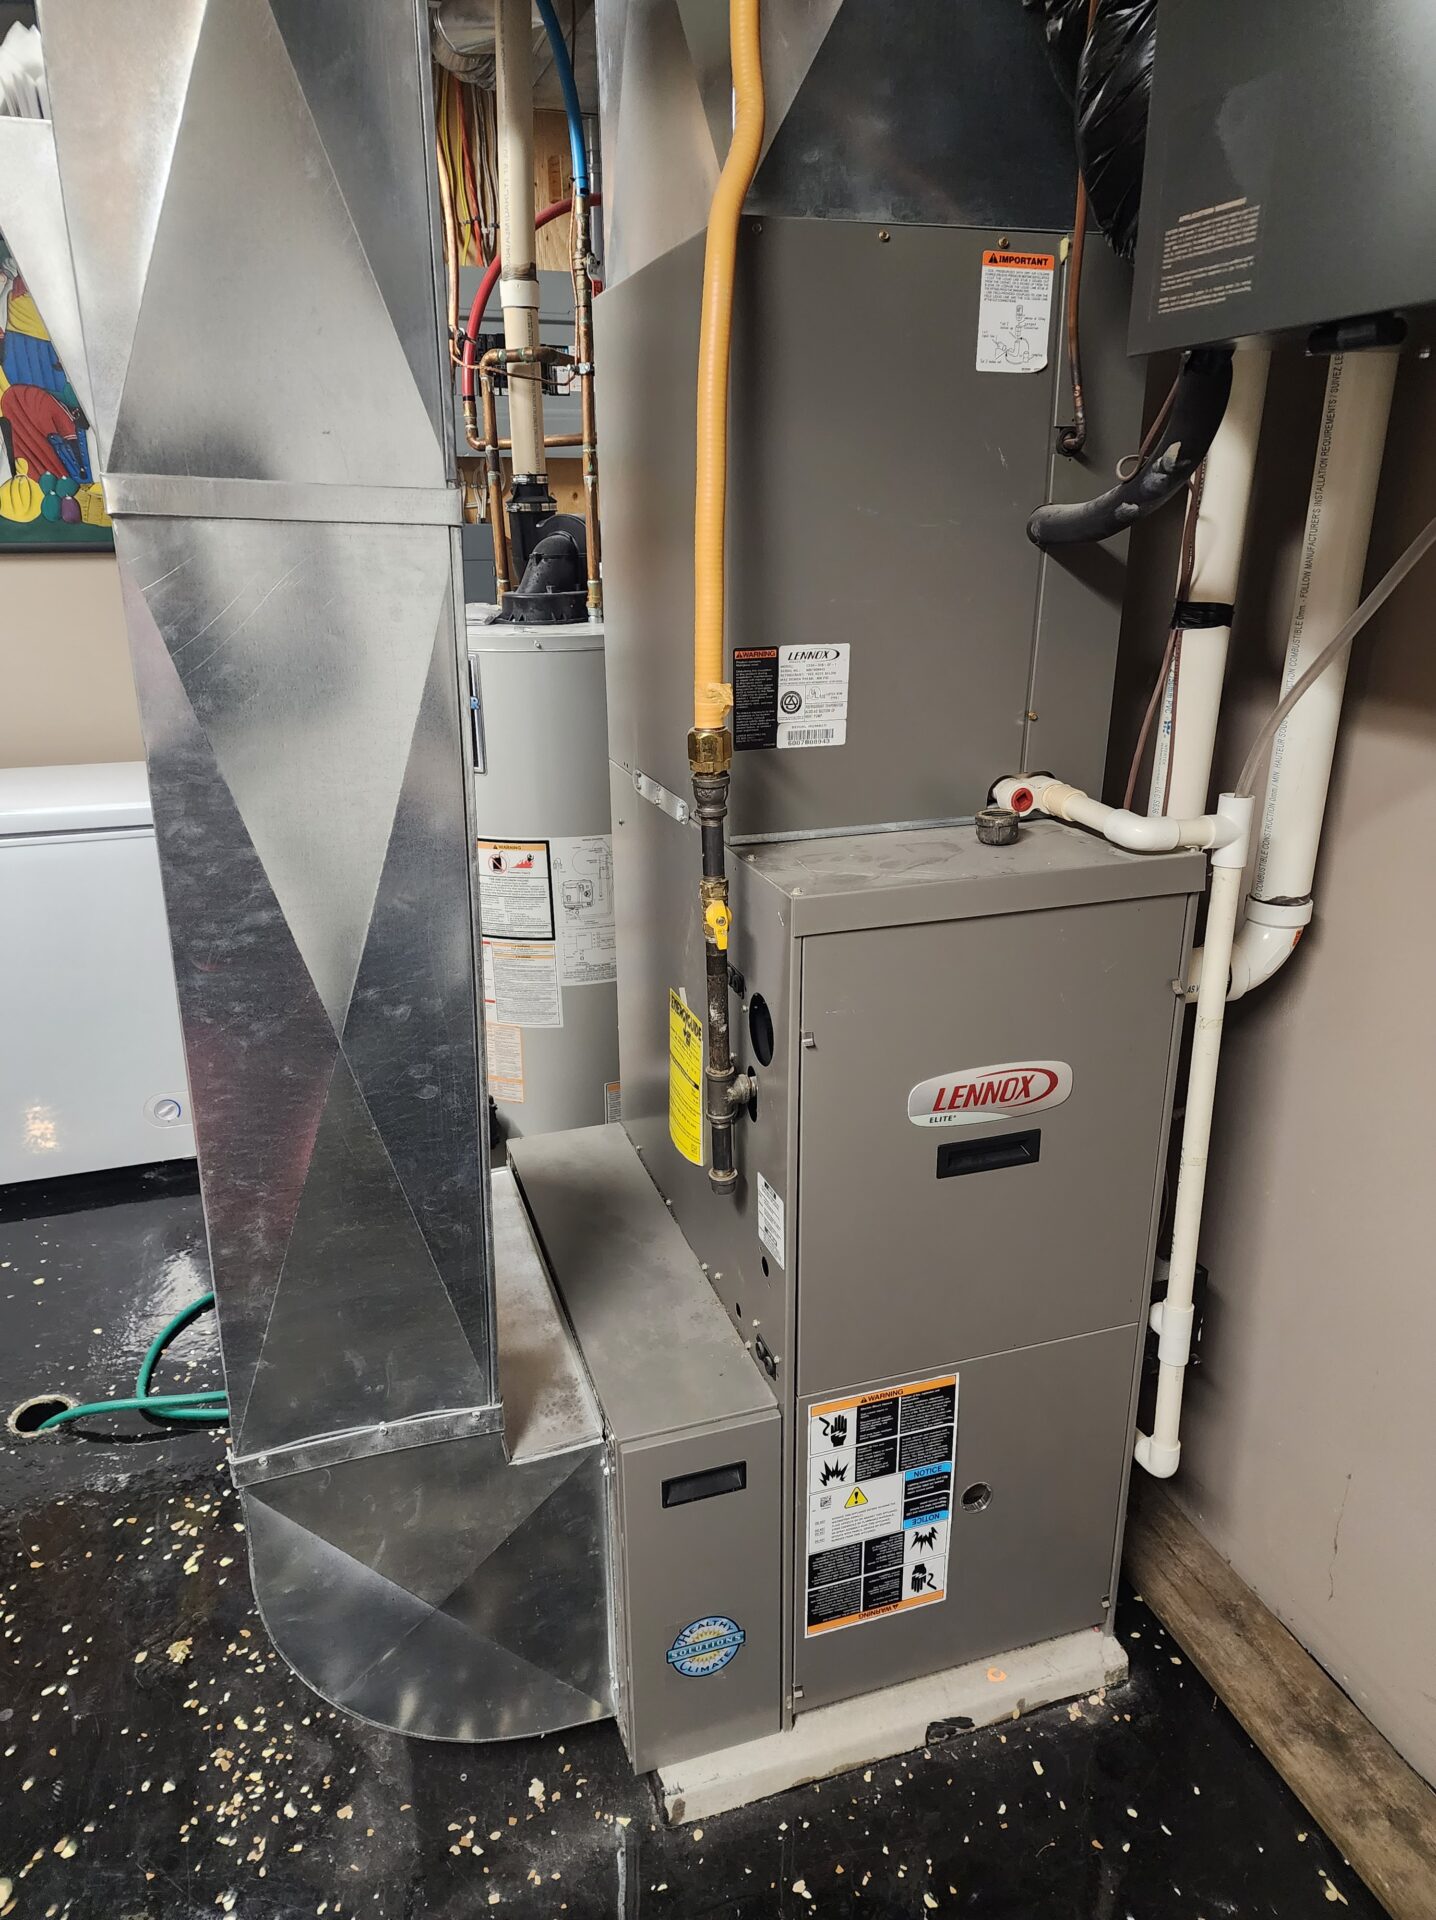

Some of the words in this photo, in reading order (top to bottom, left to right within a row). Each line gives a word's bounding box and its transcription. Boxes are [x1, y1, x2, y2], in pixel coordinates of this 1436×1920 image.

[999, 255, 1049, 266] IMPORTANT
[1255, 850, 1269, 892] COMBUSTIBLE
[1262, 803, 1275, 850] CONSTRUCTION
[1274, 738, 1285, 768] HAUTEUR
[1289, 621, 1303, 666] COMBUSTIBLE
[1300, 571, 1311, 598] FOLLOW
[1314, 458, 1328, 506] INSTALLATION
[1321, 400, 1337, 456] REQUIREMENTS
[1330, 367, 1342, 393] SUIVEZ
[788, 650, 830, 661] LENNOX
[932, 1074, 1036, 1112] LENNOX
[867, 1389, 904, 1402] WARNING
[913, 1465, 942, 1478] NOTICE
[912, 1513, 940, 1526] NOTICE
[858, 1605, 892, 1619] WARNING
[678, 1620, 734, 1646] HEALTHY
[671, 1634, 742, 1658] SOLUTIONS
[679, 1650, 732, 1673] CLIMATE
